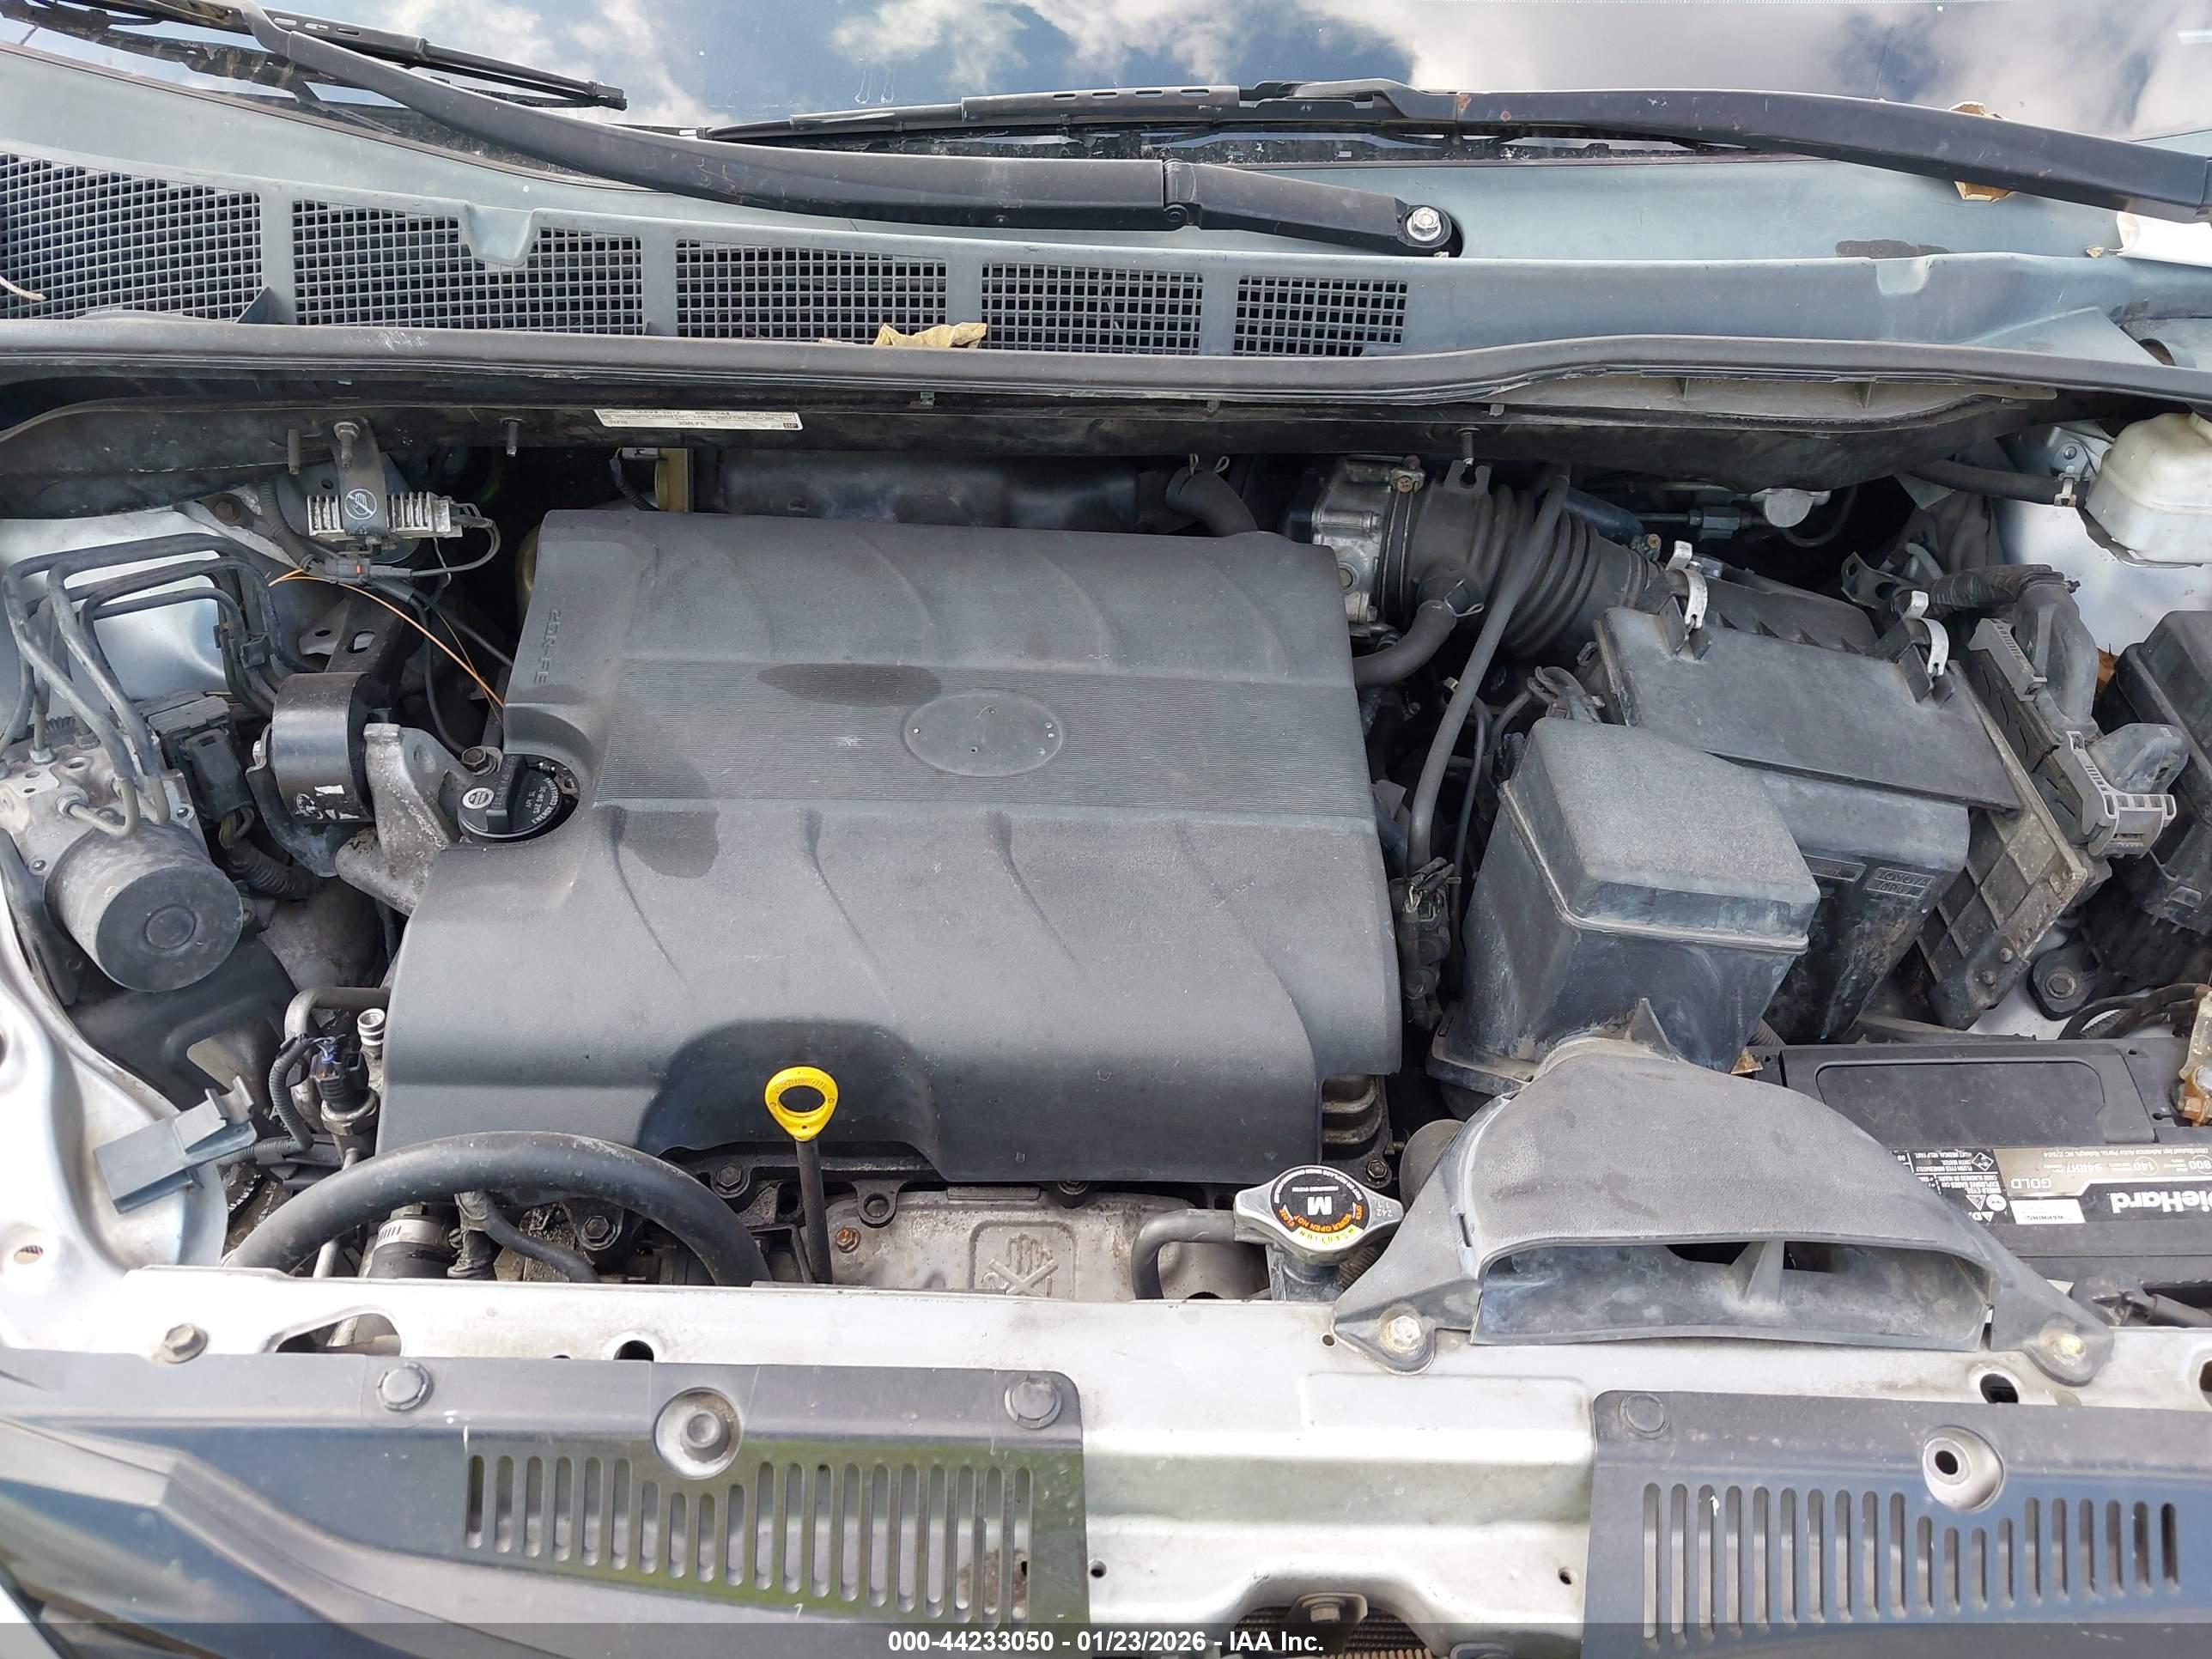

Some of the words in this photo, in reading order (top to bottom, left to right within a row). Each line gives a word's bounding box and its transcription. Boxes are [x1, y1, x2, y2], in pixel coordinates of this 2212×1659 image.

[531, 806, 554, 824] ENERGY
[2011, 1177, 2051, 1189] GOLD
[1307, 1195, 1333, 1216] M
[1310, 1224, 1332, 1232] OPEN
